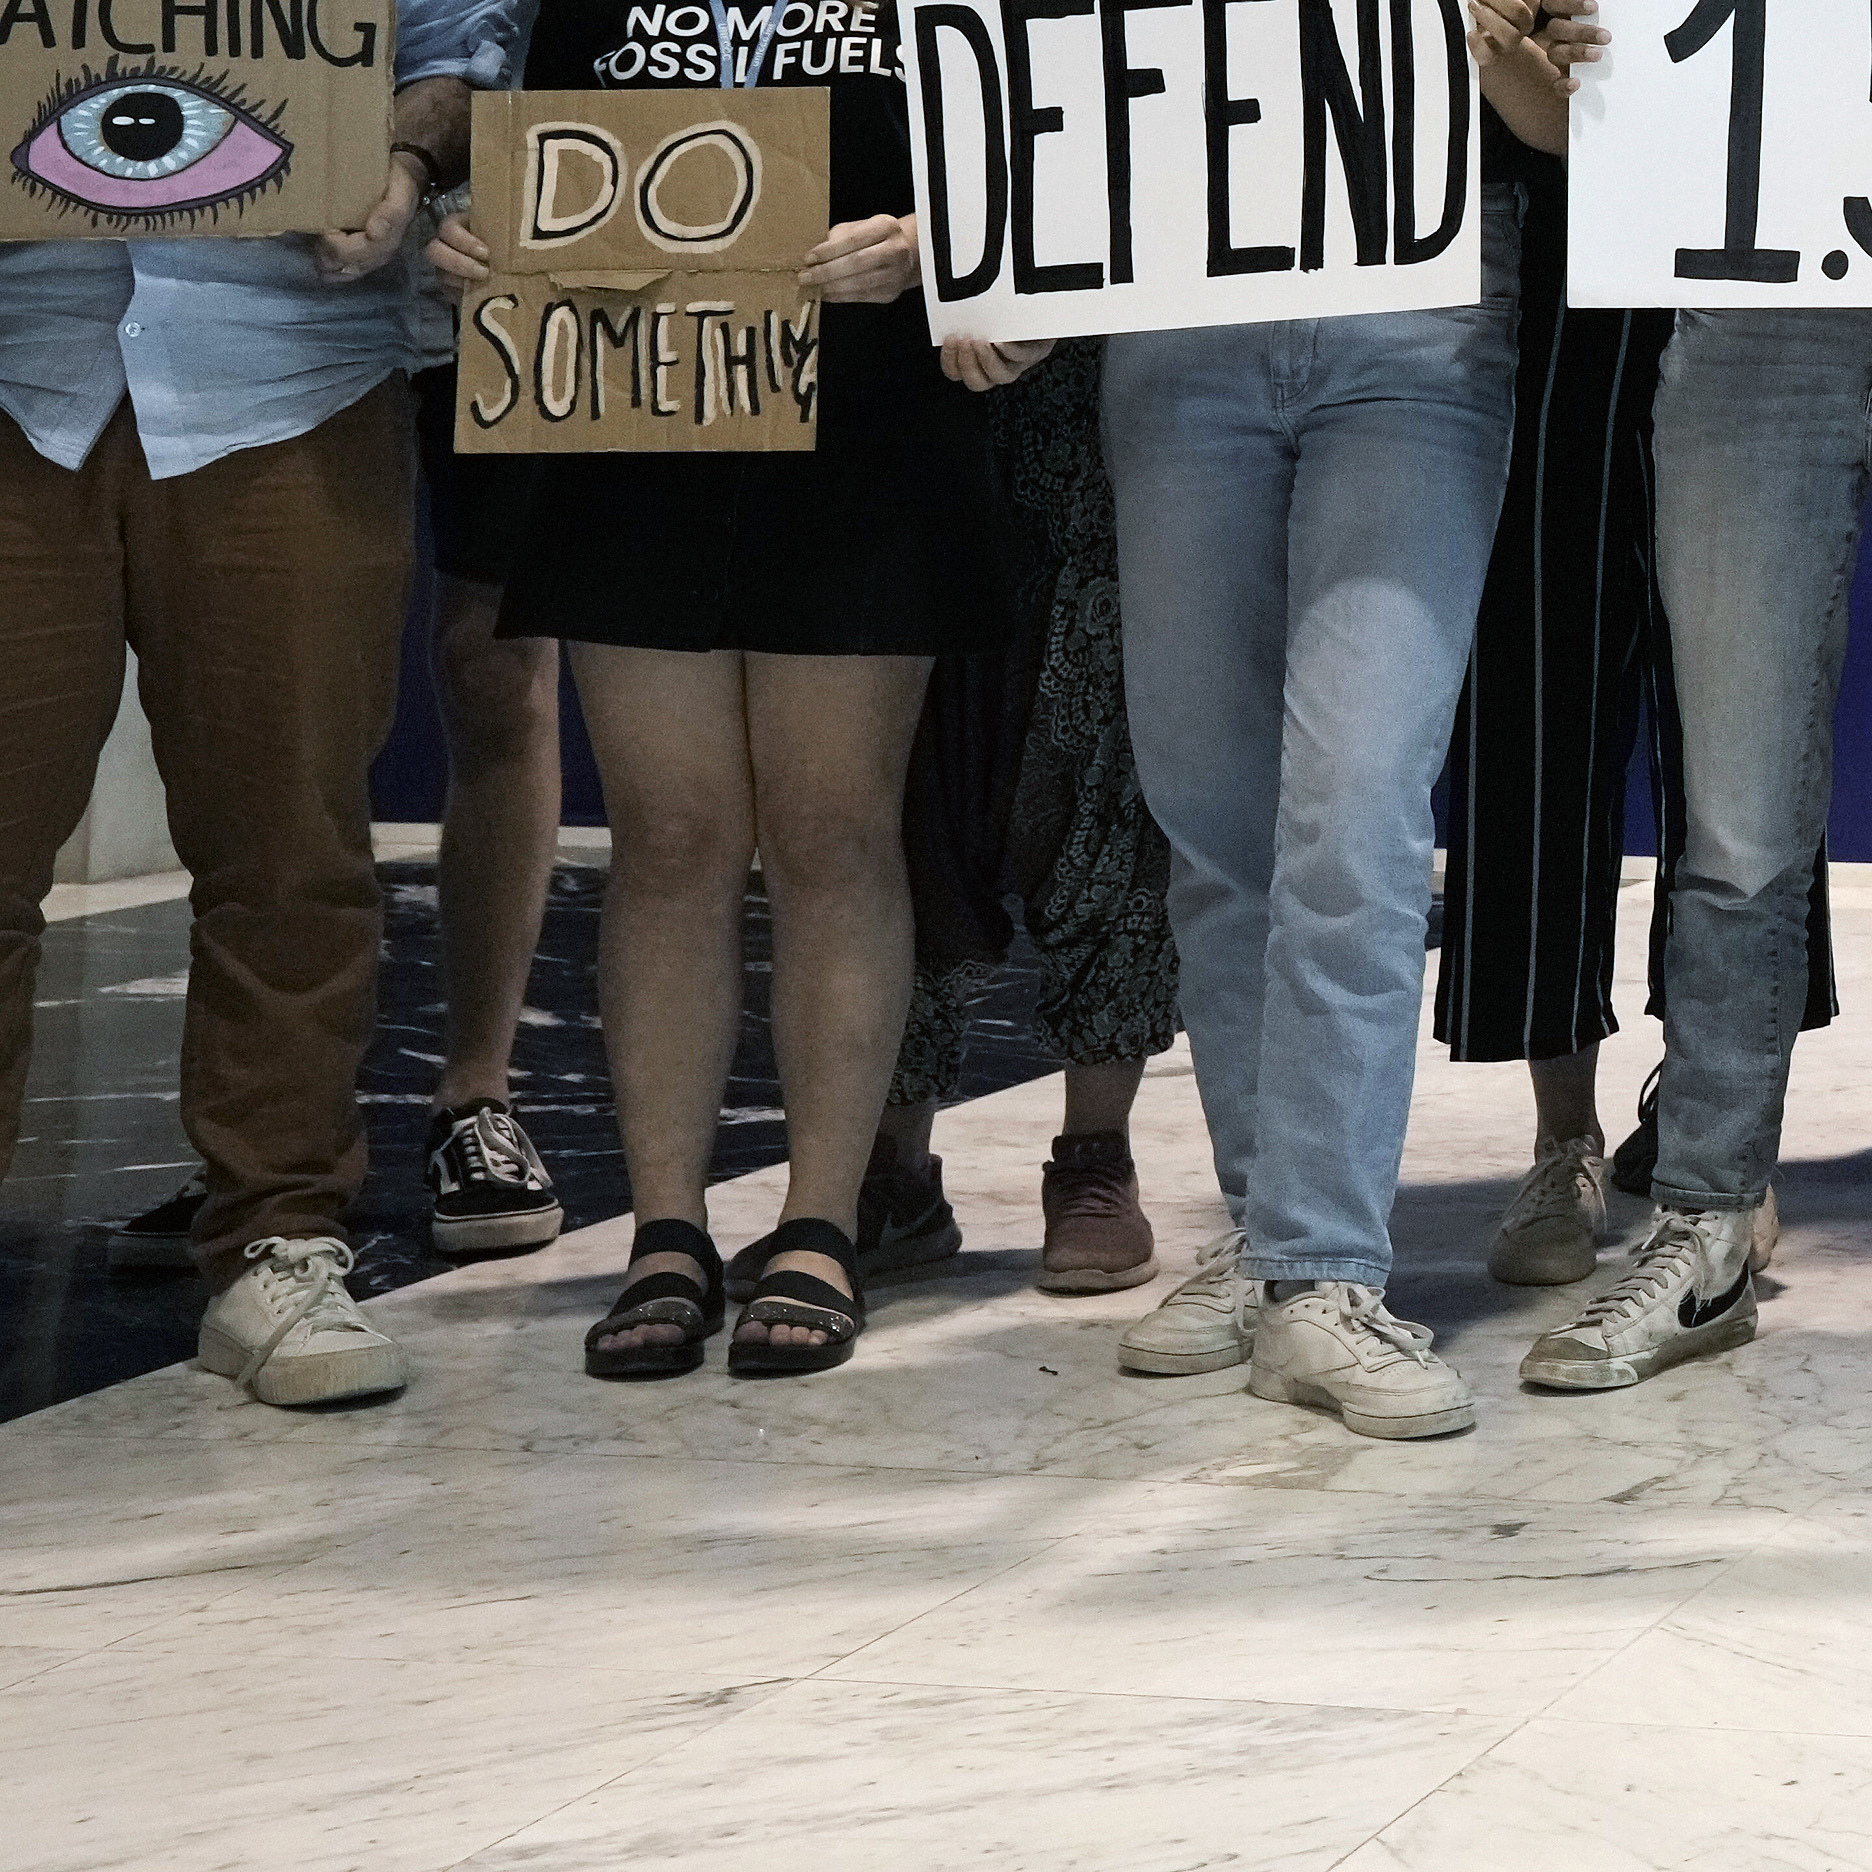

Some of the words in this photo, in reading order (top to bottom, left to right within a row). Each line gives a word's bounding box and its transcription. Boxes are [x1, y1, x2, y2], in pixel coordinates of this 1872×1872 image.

[626, 4, 709, 38] NO
[728, 0, 879, 40] MORE
[520, 121, 762, 254] DO
